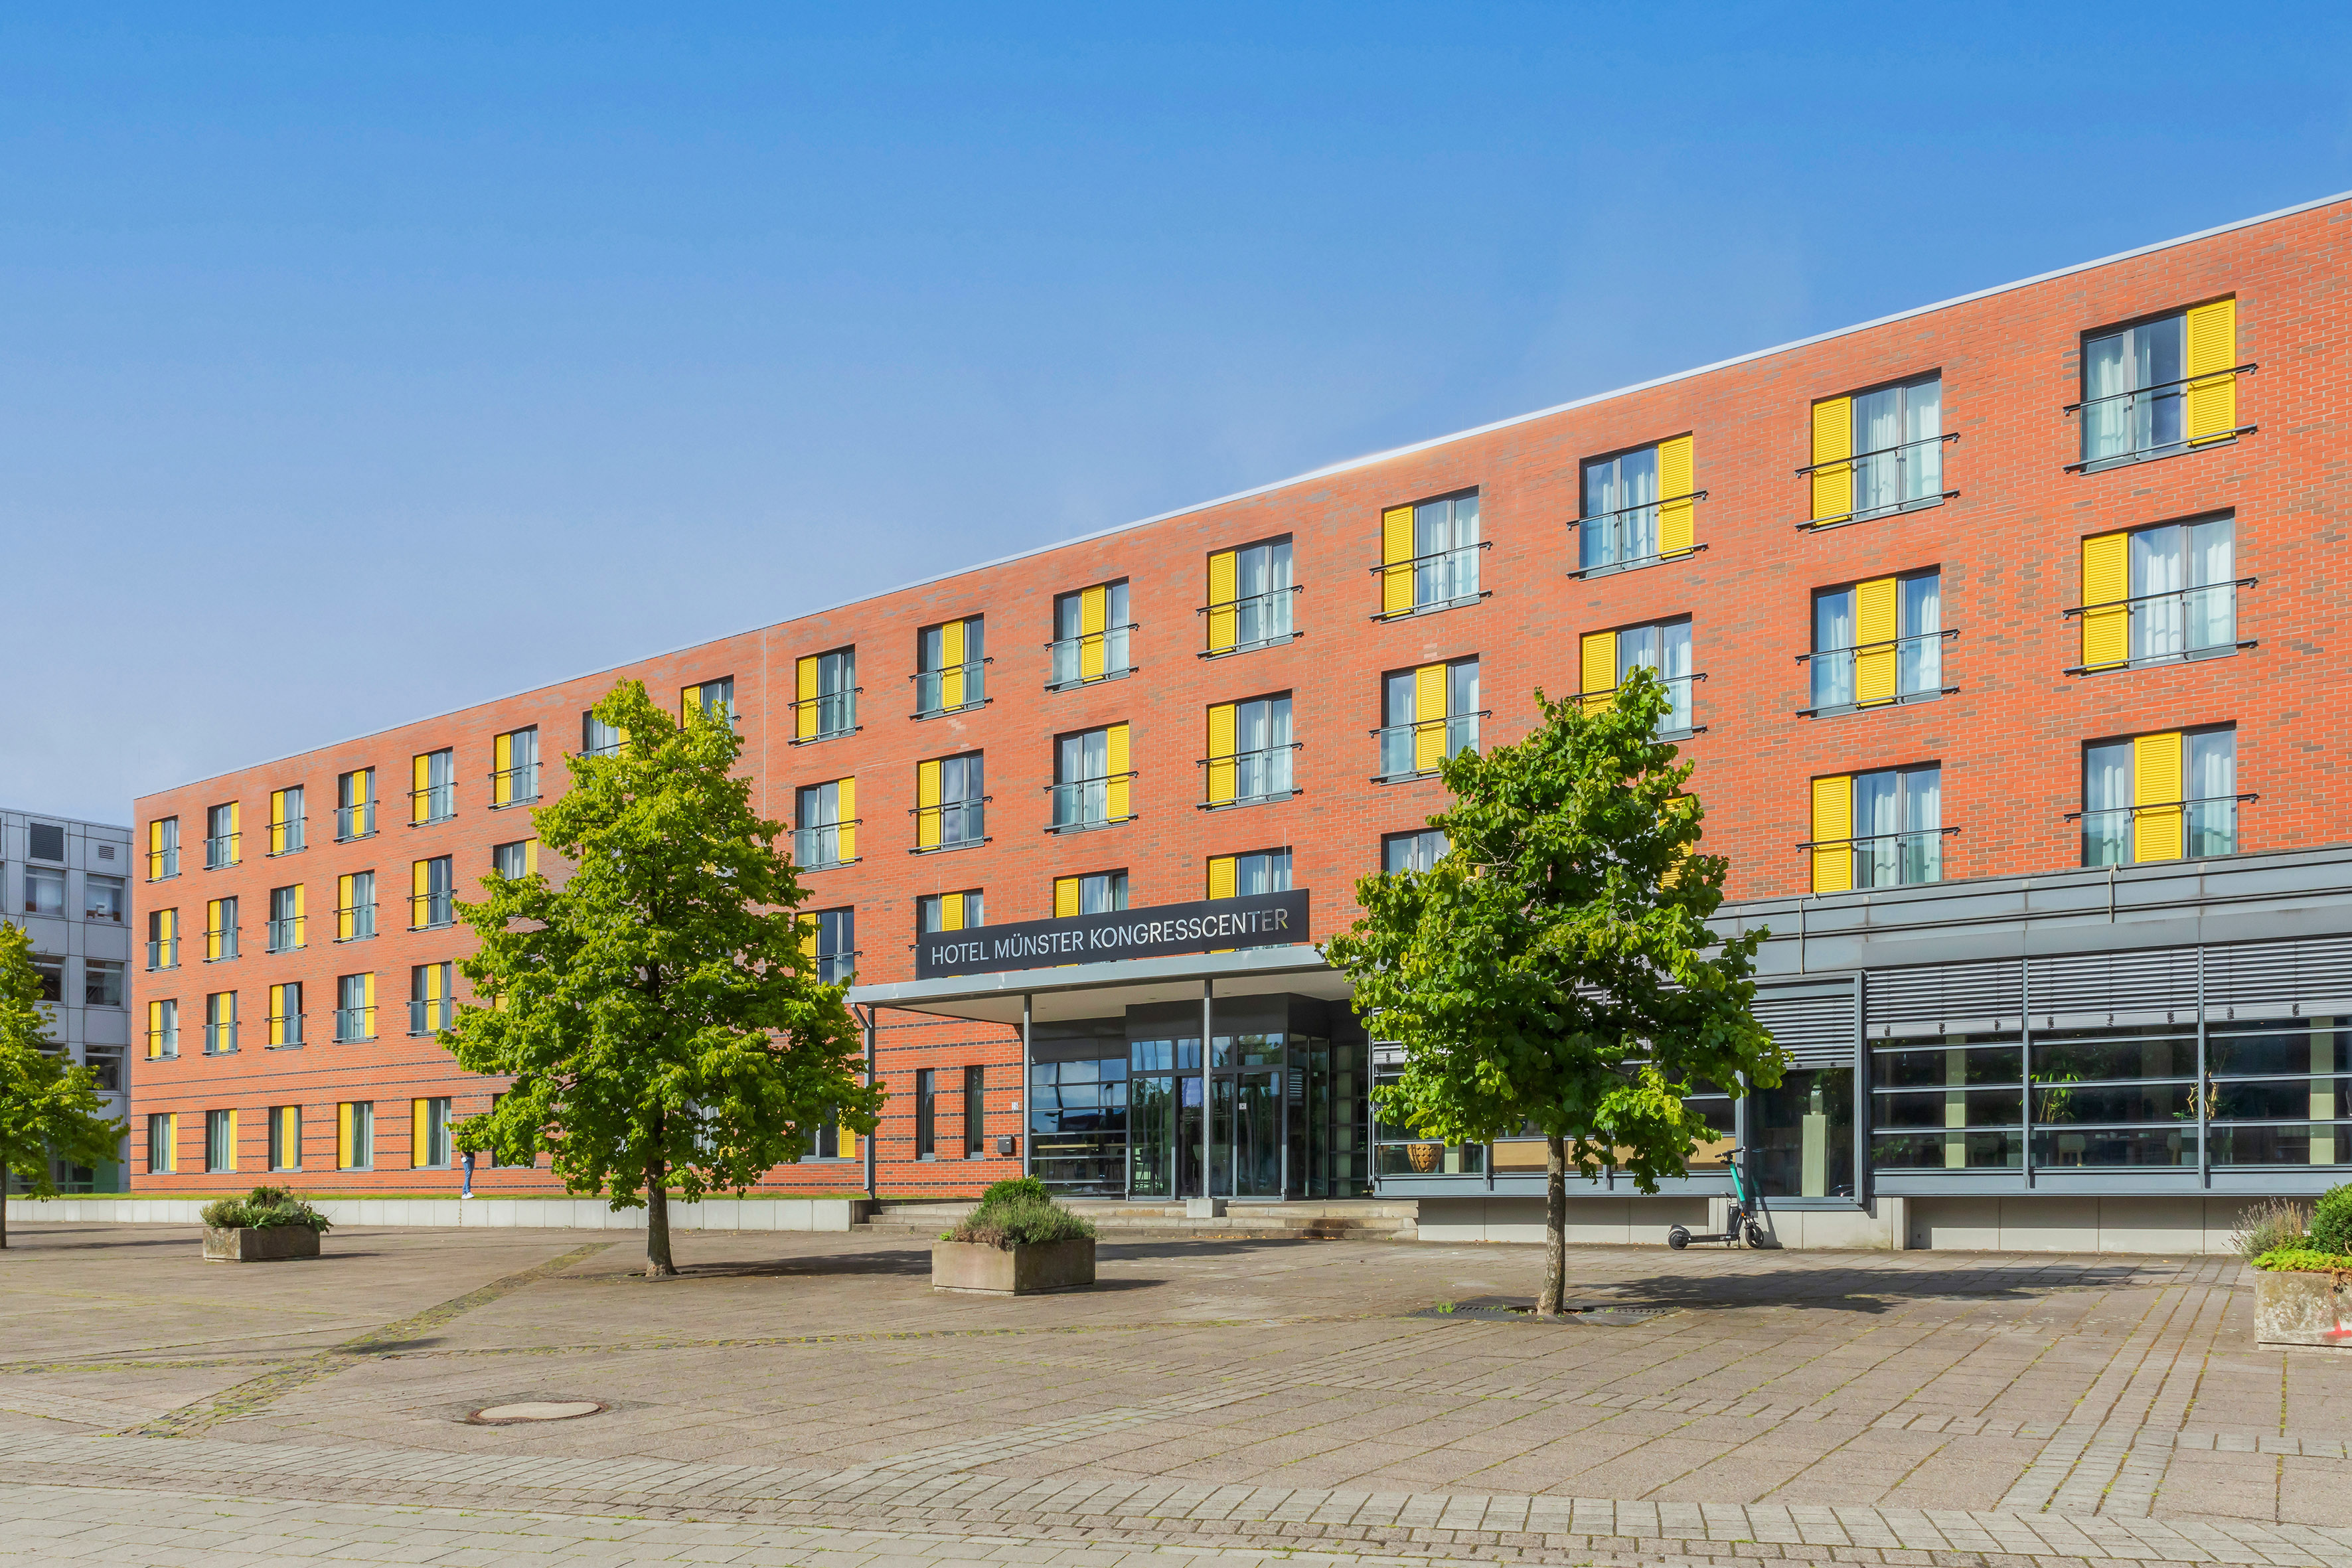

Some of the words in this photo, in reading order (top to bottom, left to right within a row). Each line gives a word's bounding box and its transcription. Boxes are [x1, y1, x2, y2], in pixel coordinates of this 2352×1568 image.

[932, 941, 989, 965] HOTEL
[994, 931, 1084, 959] MÜNSTER
[1090, 908, 1289, 949] KONGRESSCENTER
